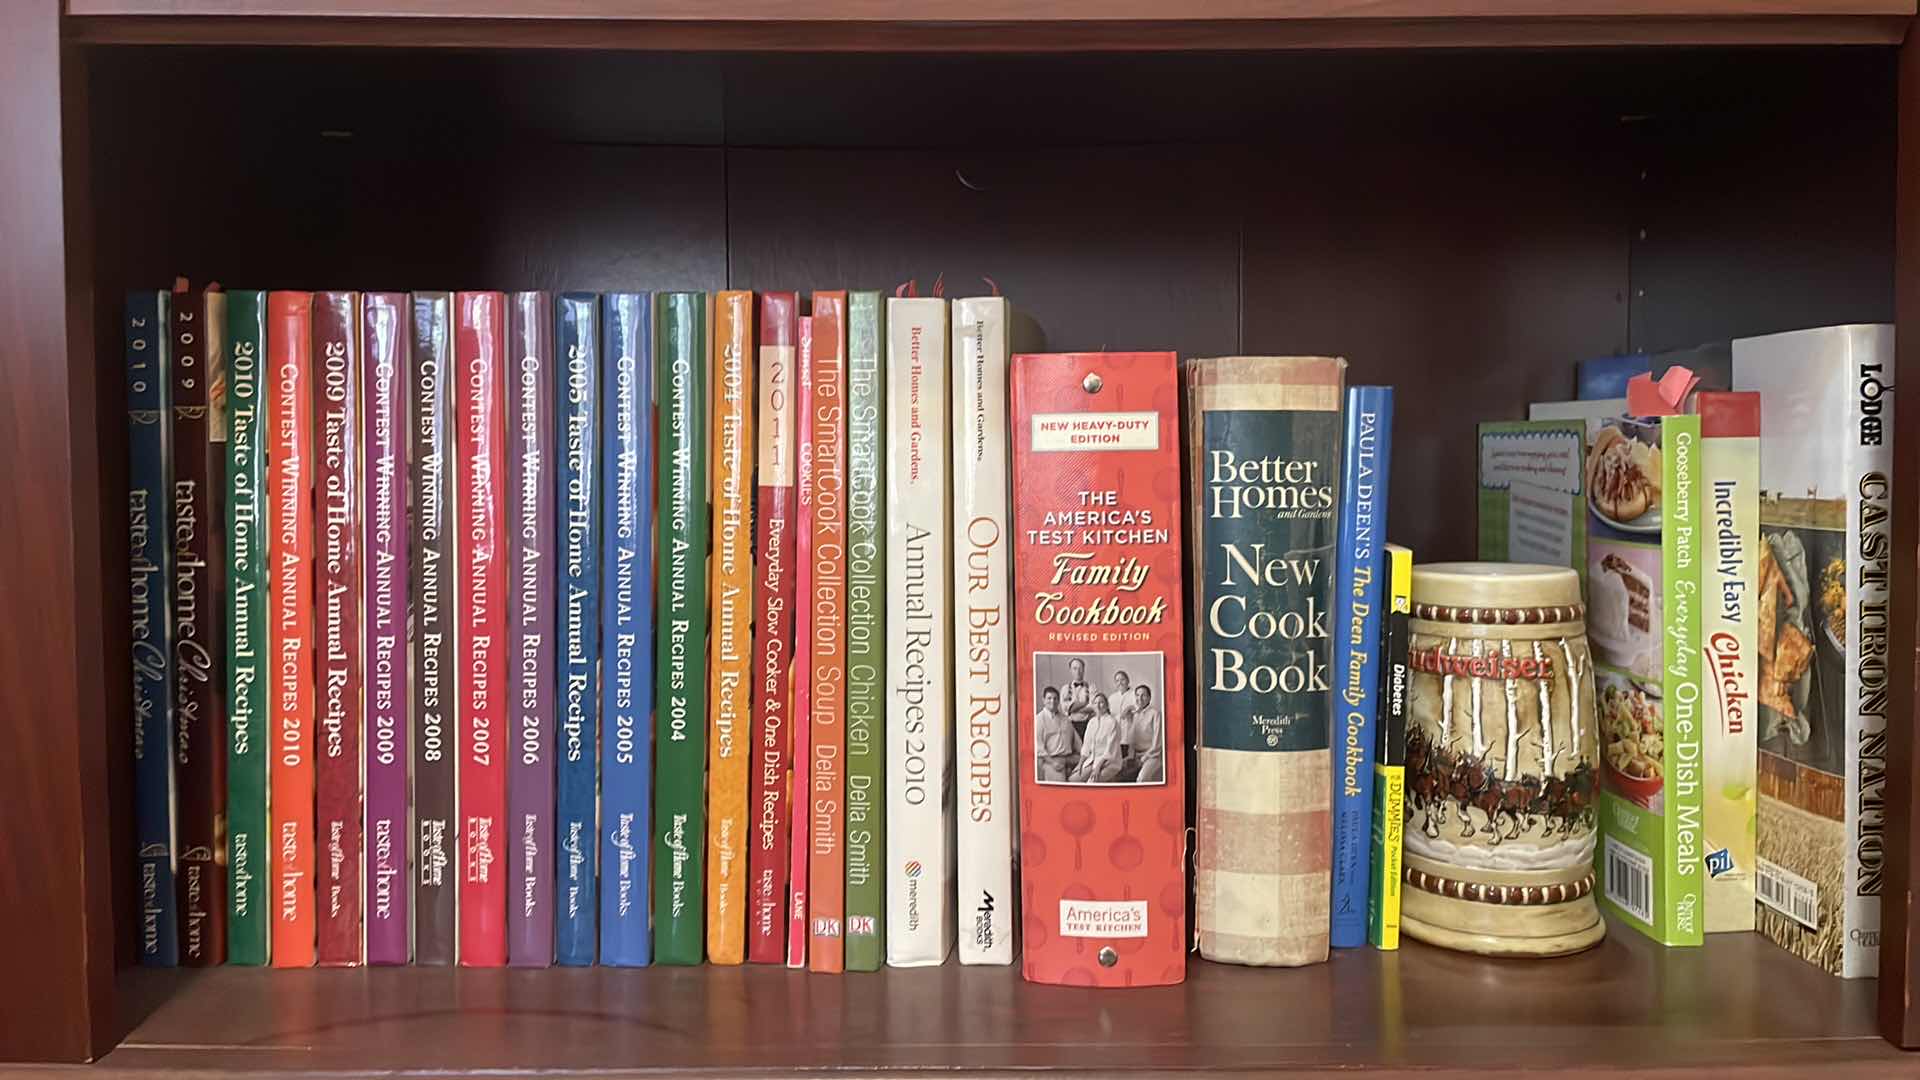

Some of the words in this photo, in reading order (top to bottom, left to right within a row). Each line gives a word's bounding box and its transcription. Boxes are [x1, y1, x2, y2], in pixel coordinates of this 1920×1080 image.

[179, 312, 194, 389] 2009
[911, 327, 922, 361] Better
[976, 321, 984, 352] Better
[234, 341, 253, 397] 2010
[326, 341, 346, 401] 2009
[521, 356, 539, 442] CONTEST
[568, 345, 587, 403] 2005
[617, 355, 635, 442] CONTEST
[724, 344, 742, 402] 2004
[817, 358, 841, 396] The
[851, 354, 877, 396] The
[911, 365, 922, 404] Homes
[976, 355, 985, 389] Homes
[280, 364, 298, 448] CONTEST
[375, 362, 393, 447] CONTEST
[420, 360, 438, 446] CONTEST
[470, 359, 487, 443] CONTEST
[672, 360, 690, 440] CONTEST
[911, 406, 921, 428] and
[976, 391, 985, 411] and
[1041, 422, 1068, 431] NEW
[1072, 421, 1149, 430] HEAVY-DUTY
[1860, 364, 1882, 445] LODGE
[234, 405, 254, 464] Taste
[326, 409, 346, 468] Taste
[568, 412, 587, 470] Taste
[723, 411, 740, 469] Taste
[1071, 435, 1120, 444] EDITION
[1360, 412, 1376, 478] PAULA
[234, 473, 254, 499] of
[327, 475, 346, 499] of
[522, 450, 541, 538] WINNING
[568, 479, 587, 501] of
[618, 450, 636, 538] WINNING
[672, 448, 690, 530] WINNING
[724, 478, 741, 501] of
[801, 443, 812, 505] COOKIES
[817, 406, 841, 534] SmartCook
[851, 406, 876, 534] SmartCook
[1211, 449, 1318, 482] Better
[1674, 432, 1691, 520] Gooseberry
[282, 456, 300, 544] WINNING
[376, 455, 393, 543] WINNING
[422, 454, 439, 540] WINNING
[471, 453, 488, 540] WINNING
[1044, 510, 1152, 525] AMERICA'S
[1079, 491, 1117, 506] THE
[1210, 485, 1332, 519] Homes
[1277, 509, 1297, 518] and
[1355, 484, 1375, 559] DEEN'S
[235, 503, 253, 571] Home
[328, 510, 346, 574] Home
[568, 512, 587, 576] Home
[722, 510, 740, 574] Home
[765, 518, 784, 591] Everyday
[968, 517, 1000, 593] OUR
[1027, 530, 1074, 545] TEST
[1082, 529, 1169, 544] KITCHEN
[1676, 526, 1694, 568] Patch
[1714, 481, 1744, 576] Incredibly
[1859, 473, 1888, 592] CAST
[282, 552, 300, 630] ANNUAL
[376, 550, 394, 628] ANNUAL
[423, 547, 440, 626] ANNUAL
[471, 549, 490, 627] ANNUAL
[523, 547, 541, 626] ANNUAL
[618, 547, 635, 625] ANNUAL
[672, 538, 689, 612] ANNUAL
[905, 523, 932, 620] Annual
[1051, 551, 1150, 590] Family
[1220, 544, 1320, 586] New
[1354, 566, 1371, 597] The
[235, 577, 254, 656] Annual
[328, 580, 347, 660] Annual
[568, 584, 588, 663] Annual
[722, 581, 740, 660] Annual
[767, 597, 781, 635] Slow
[816, 543, 841, 655] Collection
[851, 543, 876, 654] Collection
[1035, 592, 1167, 624] Cookbook
[1210, 595, 1329, 639] Cook
[1351, 602, 1369, 644] Deen
[1721, 582, 1745, 623] Easy
[672, 620, 689, 689] RECIPES
[969, 605, 1000, 683] BEST
[1049, 633, 1097, 641] REVISED
[1103, 632, 1150, 641] EDITION
[1668, 580, 1695, 678] Everyday
[1858, 600, 1889, 718] IRON
[283, 638, 301, 711] RECIPES
[376, 636, 394, 710] RECIPES
[424, 633, 442, 706] RECIPES
[473, 636, 490, 710] RECIPES
[523, 634, 541, 708] RECIPES
[617, 633, 635, 708] RECIPES
[765, 639, 782, 694] Cooker
[812, 665, 841, 725] Soup
[896, 628, 932, 733] Recipes
[1210, 647, 1329, 693] Book
[1343, 649, 1367, 705] Family
[1392, 664, 1404, 715] Diabetes
[1710, 632, 1749, 734] Chicken
[231, 665, 255, 755] Recipes
[324, 669, 347, 757] Recipes
[564, 672, 587, 761] Recipes
[671, 697, 686, 741] 2004
[716, 672, 740, 757] Recipes
[765, 716, 780, 747] One
[766, 699, 780, 712] &
[850, 665, 875, 755] Chicken
[1252, 714, 1291, 725] Meredith
[1261, 724, 1284, 734] Press
[283, 718, 300, 766] 2010
[377, 716, 393, 764] 2009
[425, 713, 441, 761] 2008
[474, 717, 489, 766] 2007
[524, 716, 540, 764] 2006
[617, 715, 633, 763] 2005
[969, 695, 1001, 822] RECIPES
[1344, 712, 1365, 796] Cookbook
[1676, 683, 1698, 796] One-Dish
[763, 751, 781, 785] Dish
[816, 744, 837, 792] Delia
[904, 739, 926, 805] 2010
[760, 790, 779, 850] Recipes
[815, 800, 837, 854] Smith
[849, 775, 871, 822] Delia
[1388, 782, 1402, 842] DUMMIES
[1857, 730, 1887, 897] NATION
[849, 830, 871, 885] Smith
[1677, 804, 1700, 875] Meals
[1710, 852, 1730, 874] pil
[794, 892, 803, 920] LANE
[813, 919, 840, 937] DK
[848, 916, 875, 935] DK
[909, 879, 919, 931] meredith
[1066, 907, 1141, 921] America's
[1067, 923, 1091, 932] TEST
[1095, 923, 1141, 932] KITCHEN
